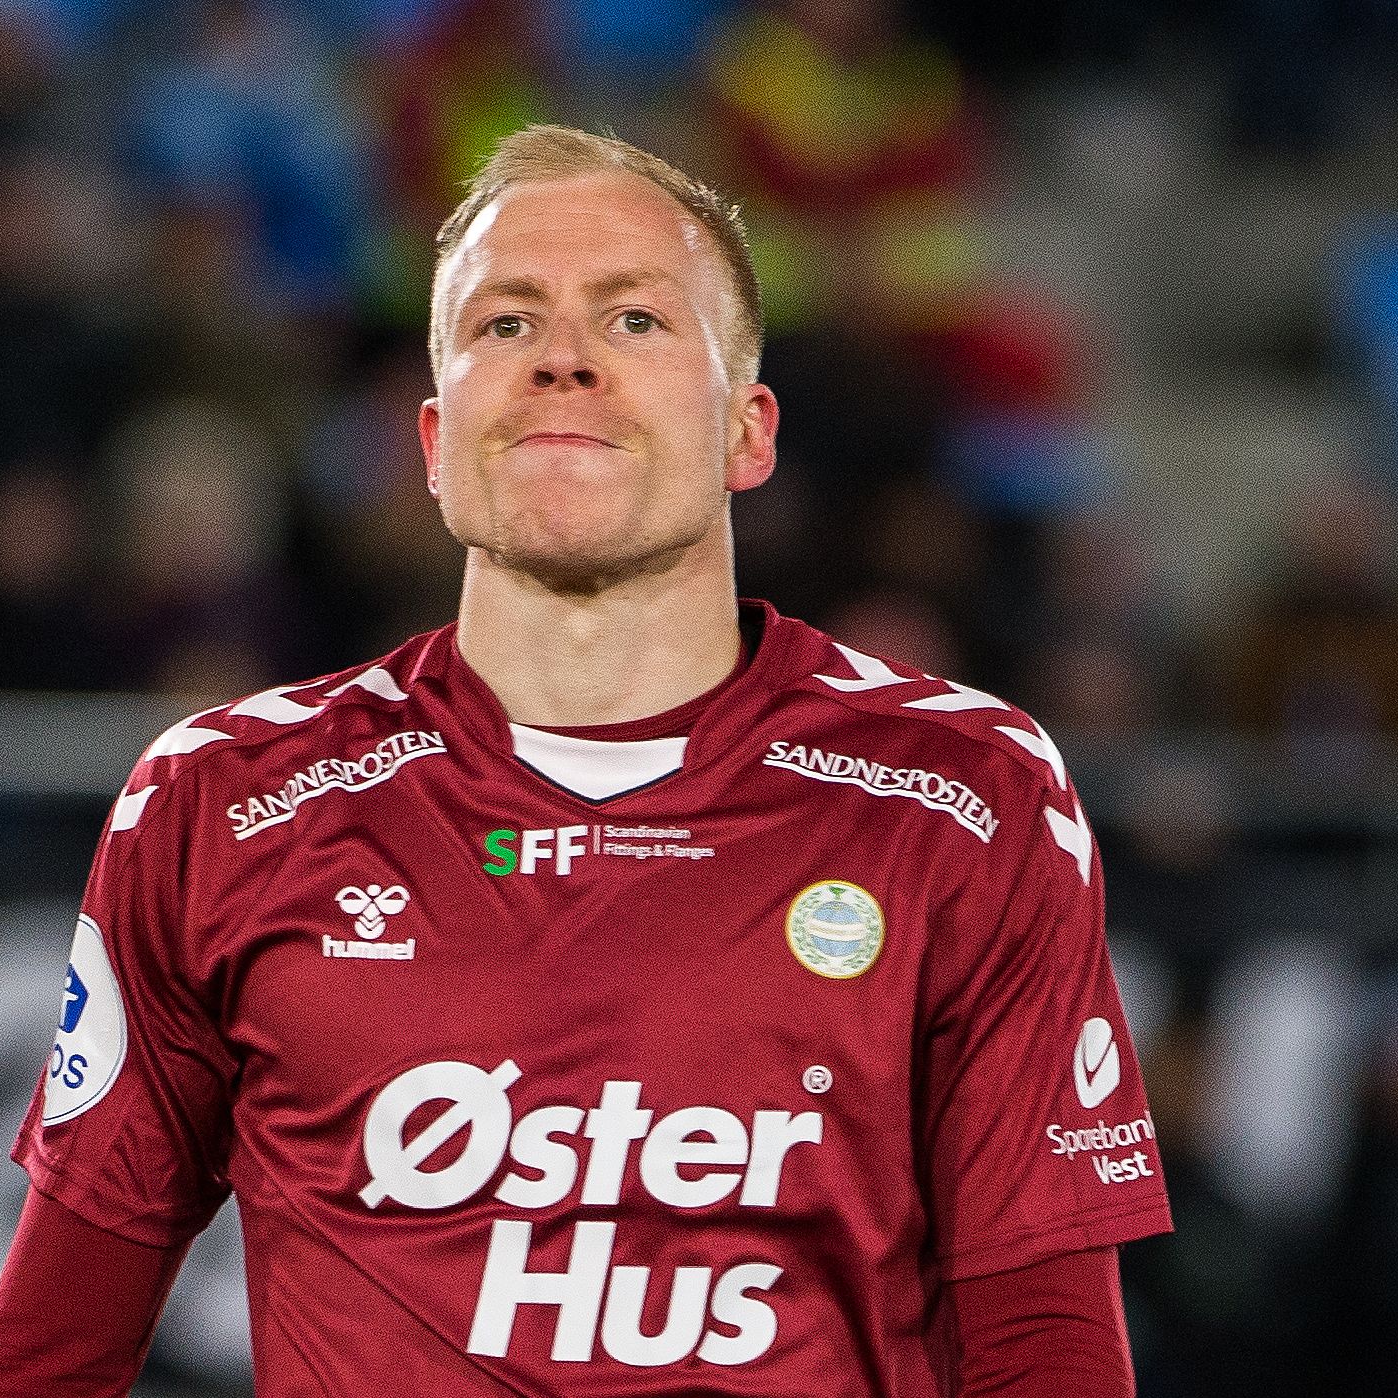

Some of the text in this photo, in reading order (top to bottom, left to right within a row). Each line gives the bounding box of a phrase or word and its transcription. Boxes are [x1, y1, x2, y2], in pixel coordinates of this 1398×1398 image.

[227, 731, 445, 832] SANDNESPOSTEN
[766, 741, 1000, 838] SANDNESPOSTEN
[482, 825, 588, 876] SFF
[322, 934, 416, 960] hummel
[358, 1059, 824, 1209] Øster
[1092, 1151, 1154, 1184] Vest
[467, 1219, 785, 1367] Hus
